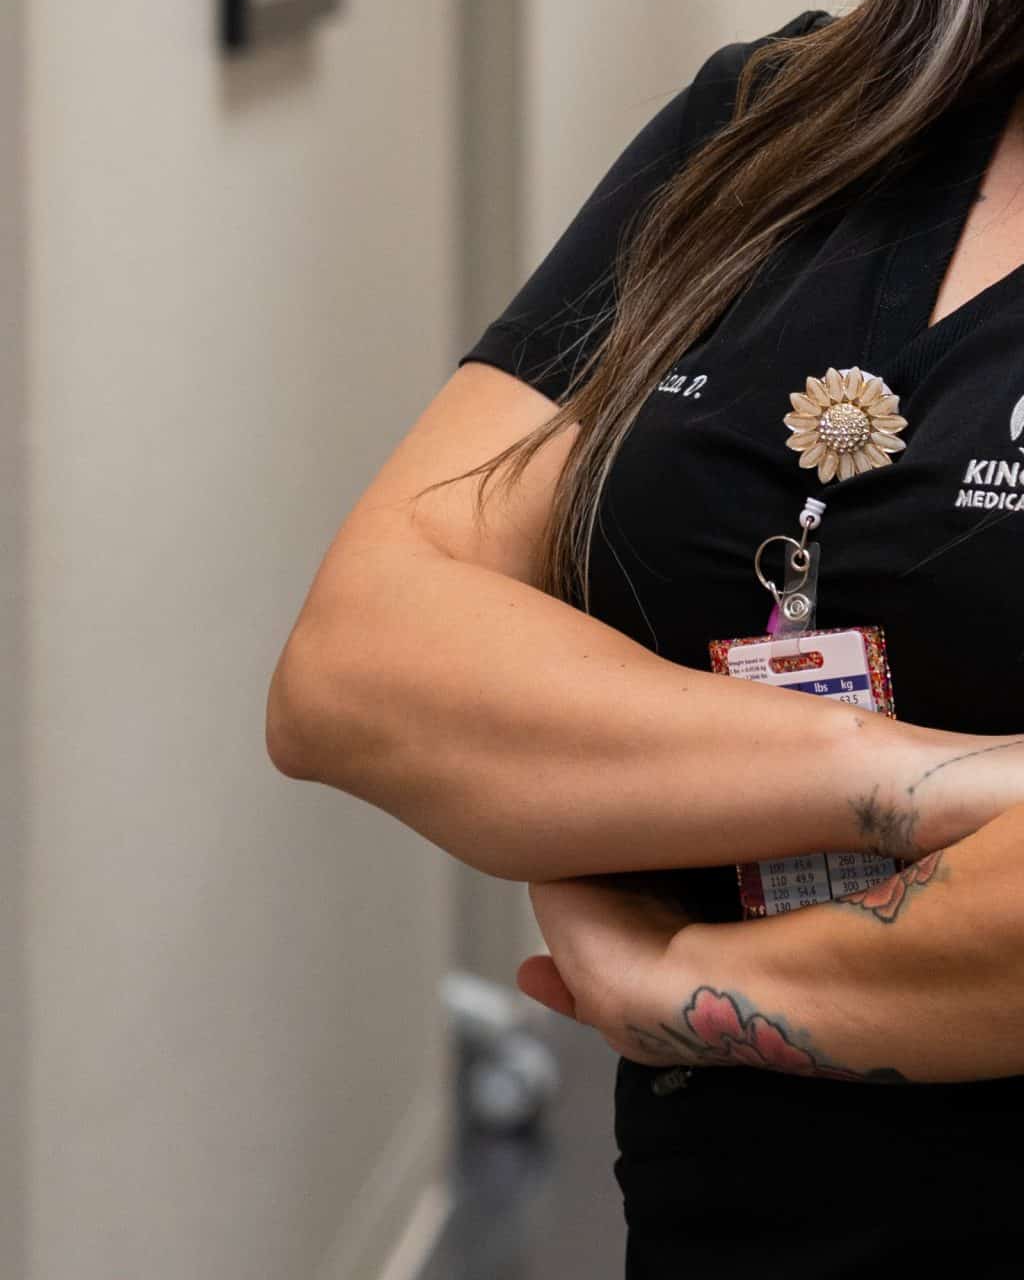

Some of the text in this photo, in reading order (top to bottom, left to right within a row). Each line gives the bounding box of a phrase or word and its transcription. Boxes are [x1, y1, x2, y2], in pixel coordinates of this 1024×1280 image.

[814, 679, 854, 693] lbs kg
[771, 875, 787, 887] 110
[774, 888, 789, 900] 120
[775, 901, 791, 913] 130
